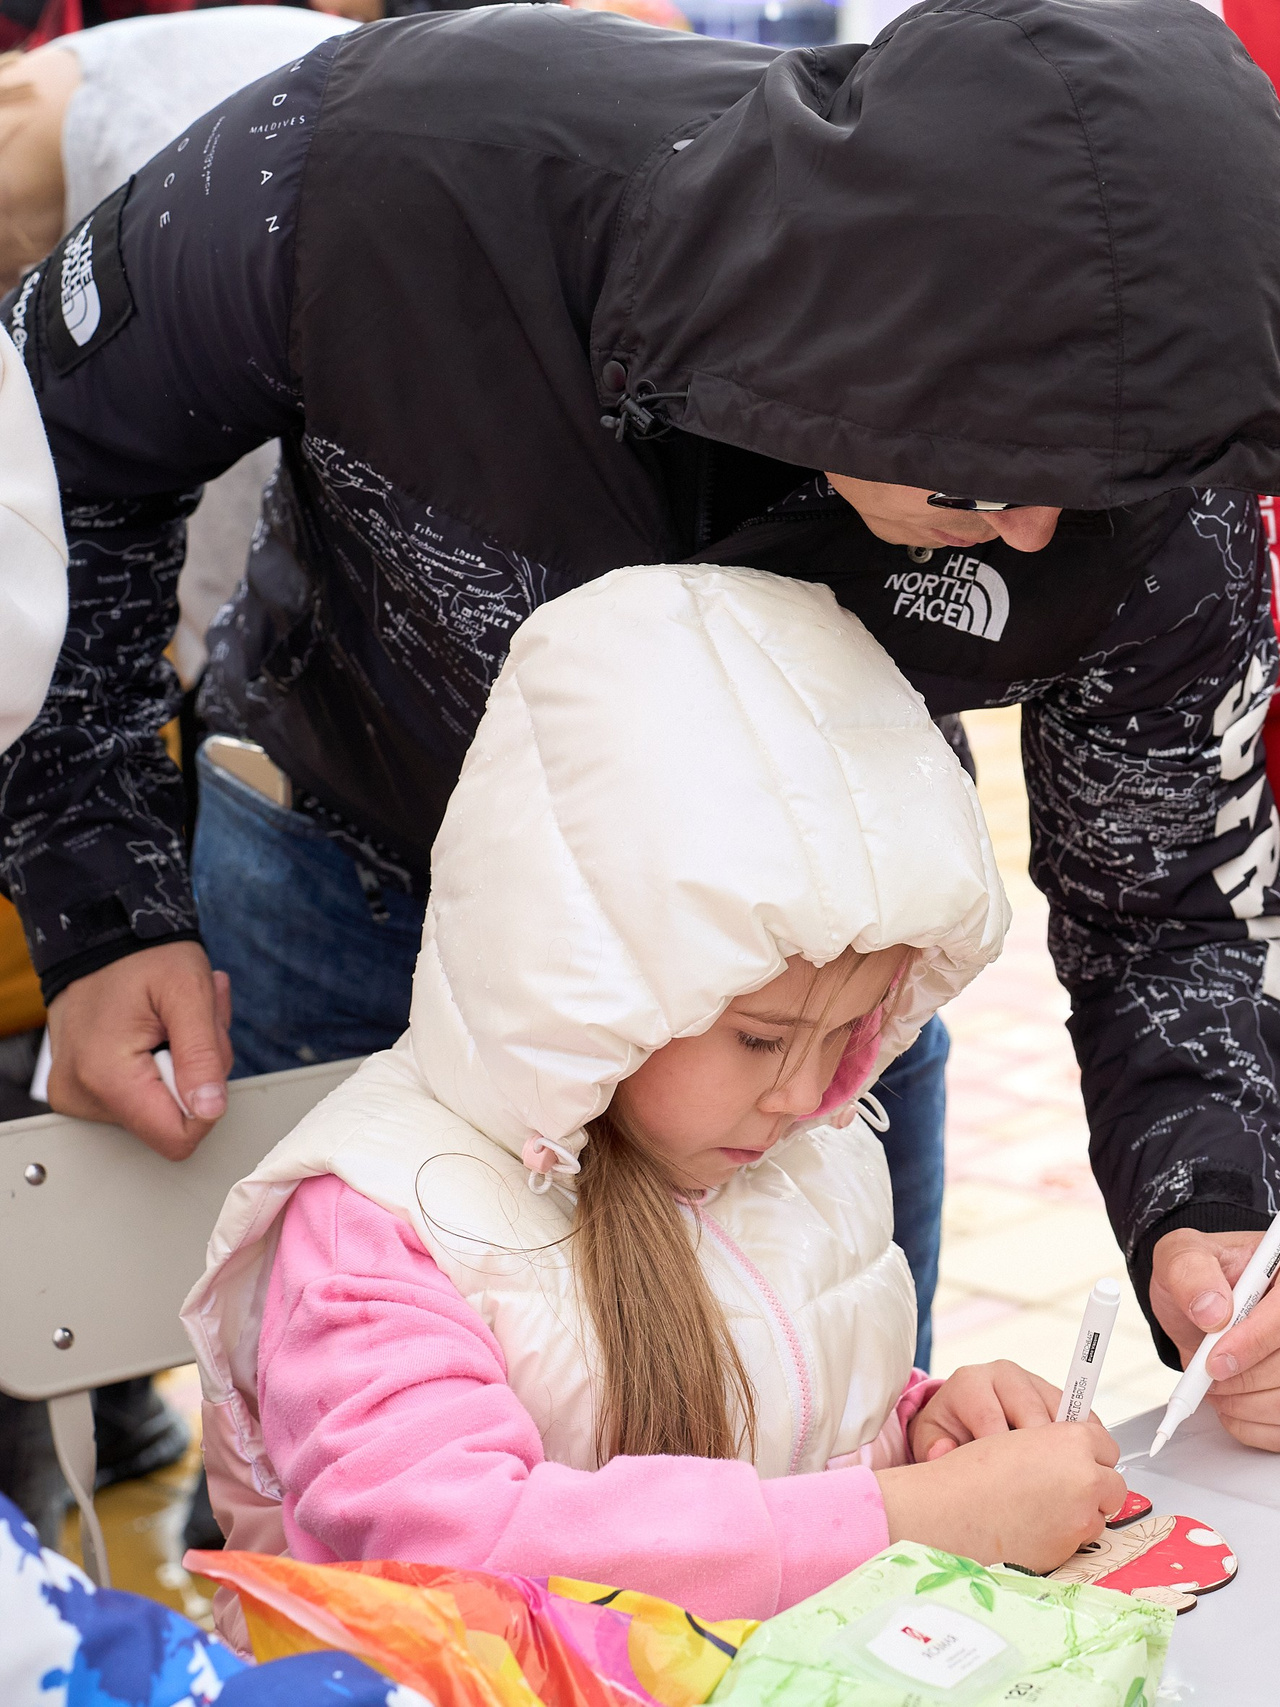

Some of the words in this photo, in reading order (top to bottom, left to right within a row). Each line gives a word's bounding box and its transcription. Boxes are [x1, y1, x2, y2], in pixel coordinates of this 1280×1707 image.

[249, 114, 306, 134] MALDIVES
[79, 235, 94, 283] THE
[12, 271, 41, 361] Supre
[413, 522, 445, 543] Tibet
[409, 533, 467, 566] Brahmaputra
[454, 547, 483, 563] Lhasa
[415, 551, 465, 580] Kathmandu
[942, 553, 980, 581] HE
[465, 583, 501, 600] BHUTAN
[884, 571, 972, 605] NORTH
[472, 609, 510, 630] DHAKA
[487, 601, 523, 623] Shillong
[892, 591, 964, 628] FACE
[1243, 1290, 1261, 1317] BRUSH
[1075, 1376, 1088, 1400] BRUSH
[1069, 1400, 1082, 1422] RYLIC
